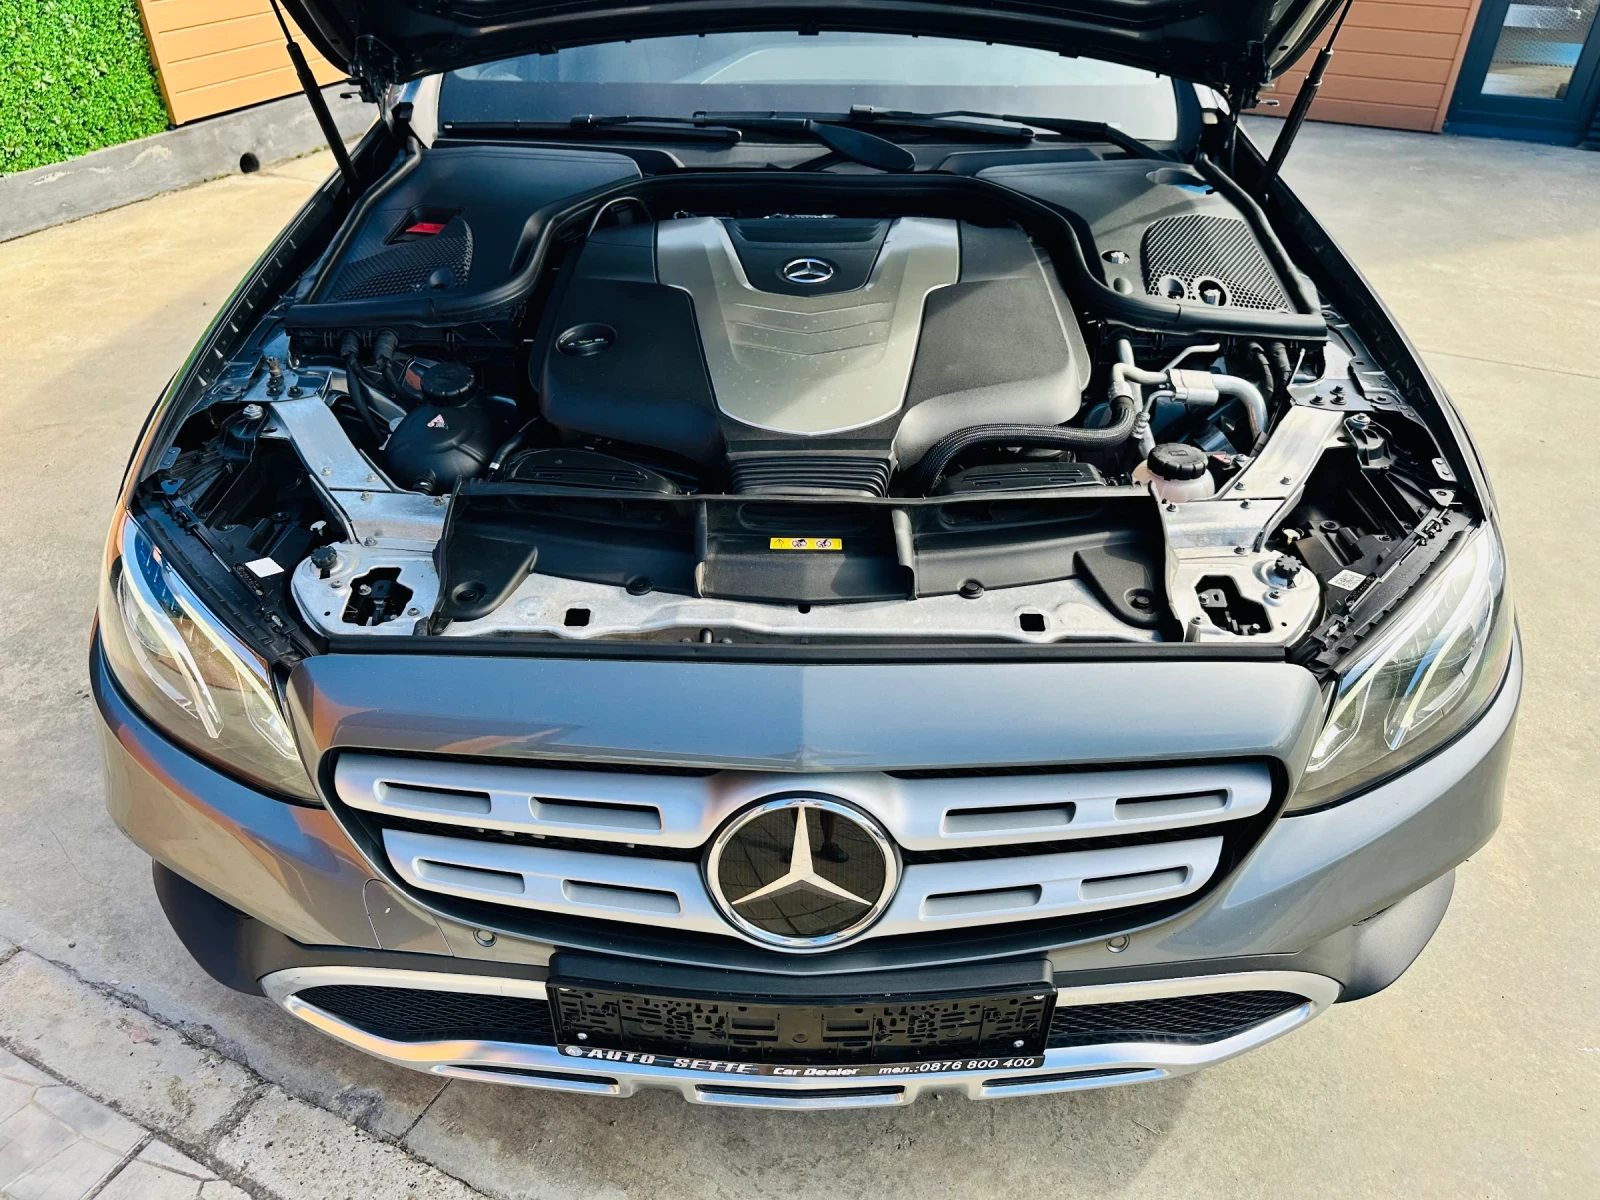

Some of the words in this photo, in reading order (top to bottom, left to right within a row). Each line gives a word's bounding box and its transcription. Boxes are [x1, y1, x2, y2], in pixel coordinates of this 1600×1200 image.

[587, 1049, 655, 1064] AUTO
[673, 1058, 753, 1074] SETTE
[773, 1067, 799, 1076] Car
[803, 1067, 860, 1076] Dealer
[966, 1059, 998, 1070] 800
[1003, 1057, 1034, 1068] 400
